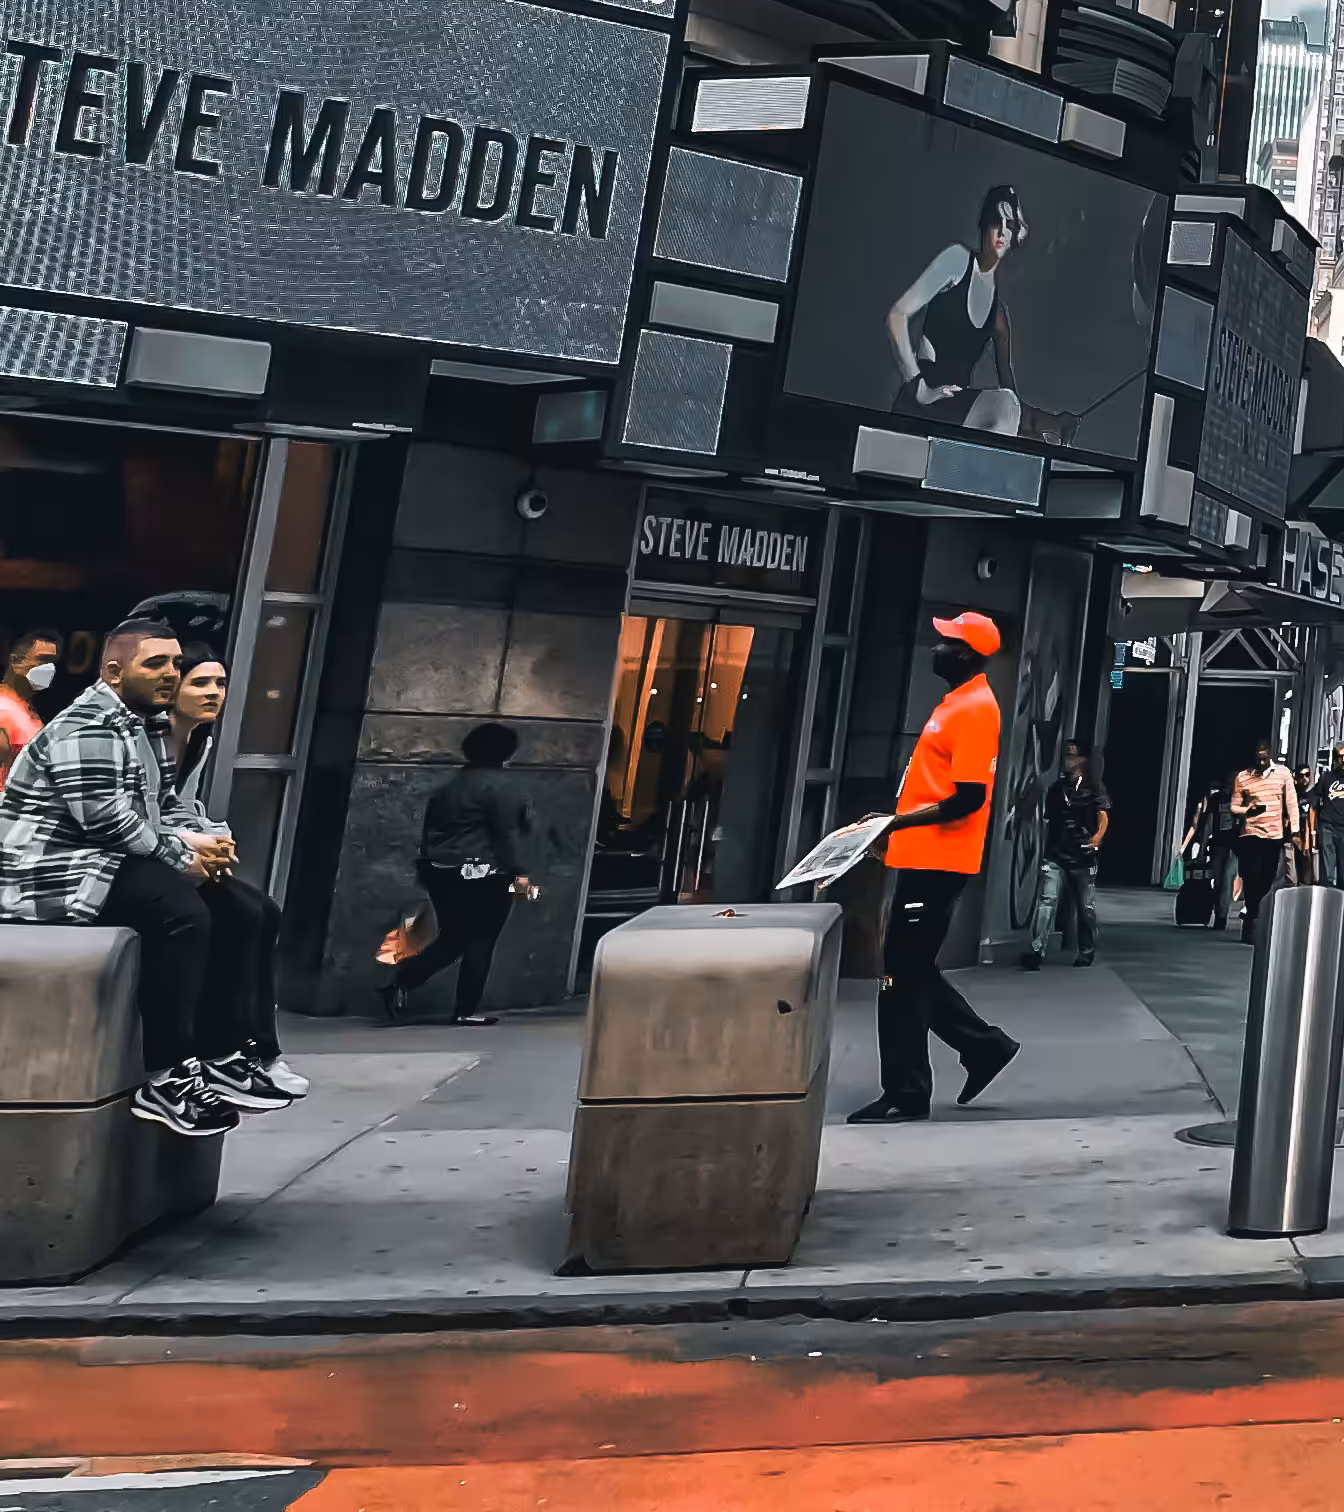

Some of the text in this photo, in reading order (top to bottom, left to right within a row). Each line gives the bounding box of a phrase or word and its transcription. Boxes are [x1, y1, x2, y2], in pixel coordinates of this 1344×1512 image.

[262, 88, 619, 240] MADDEN
[640, 515, 809, 573] STEVE MADDEN
